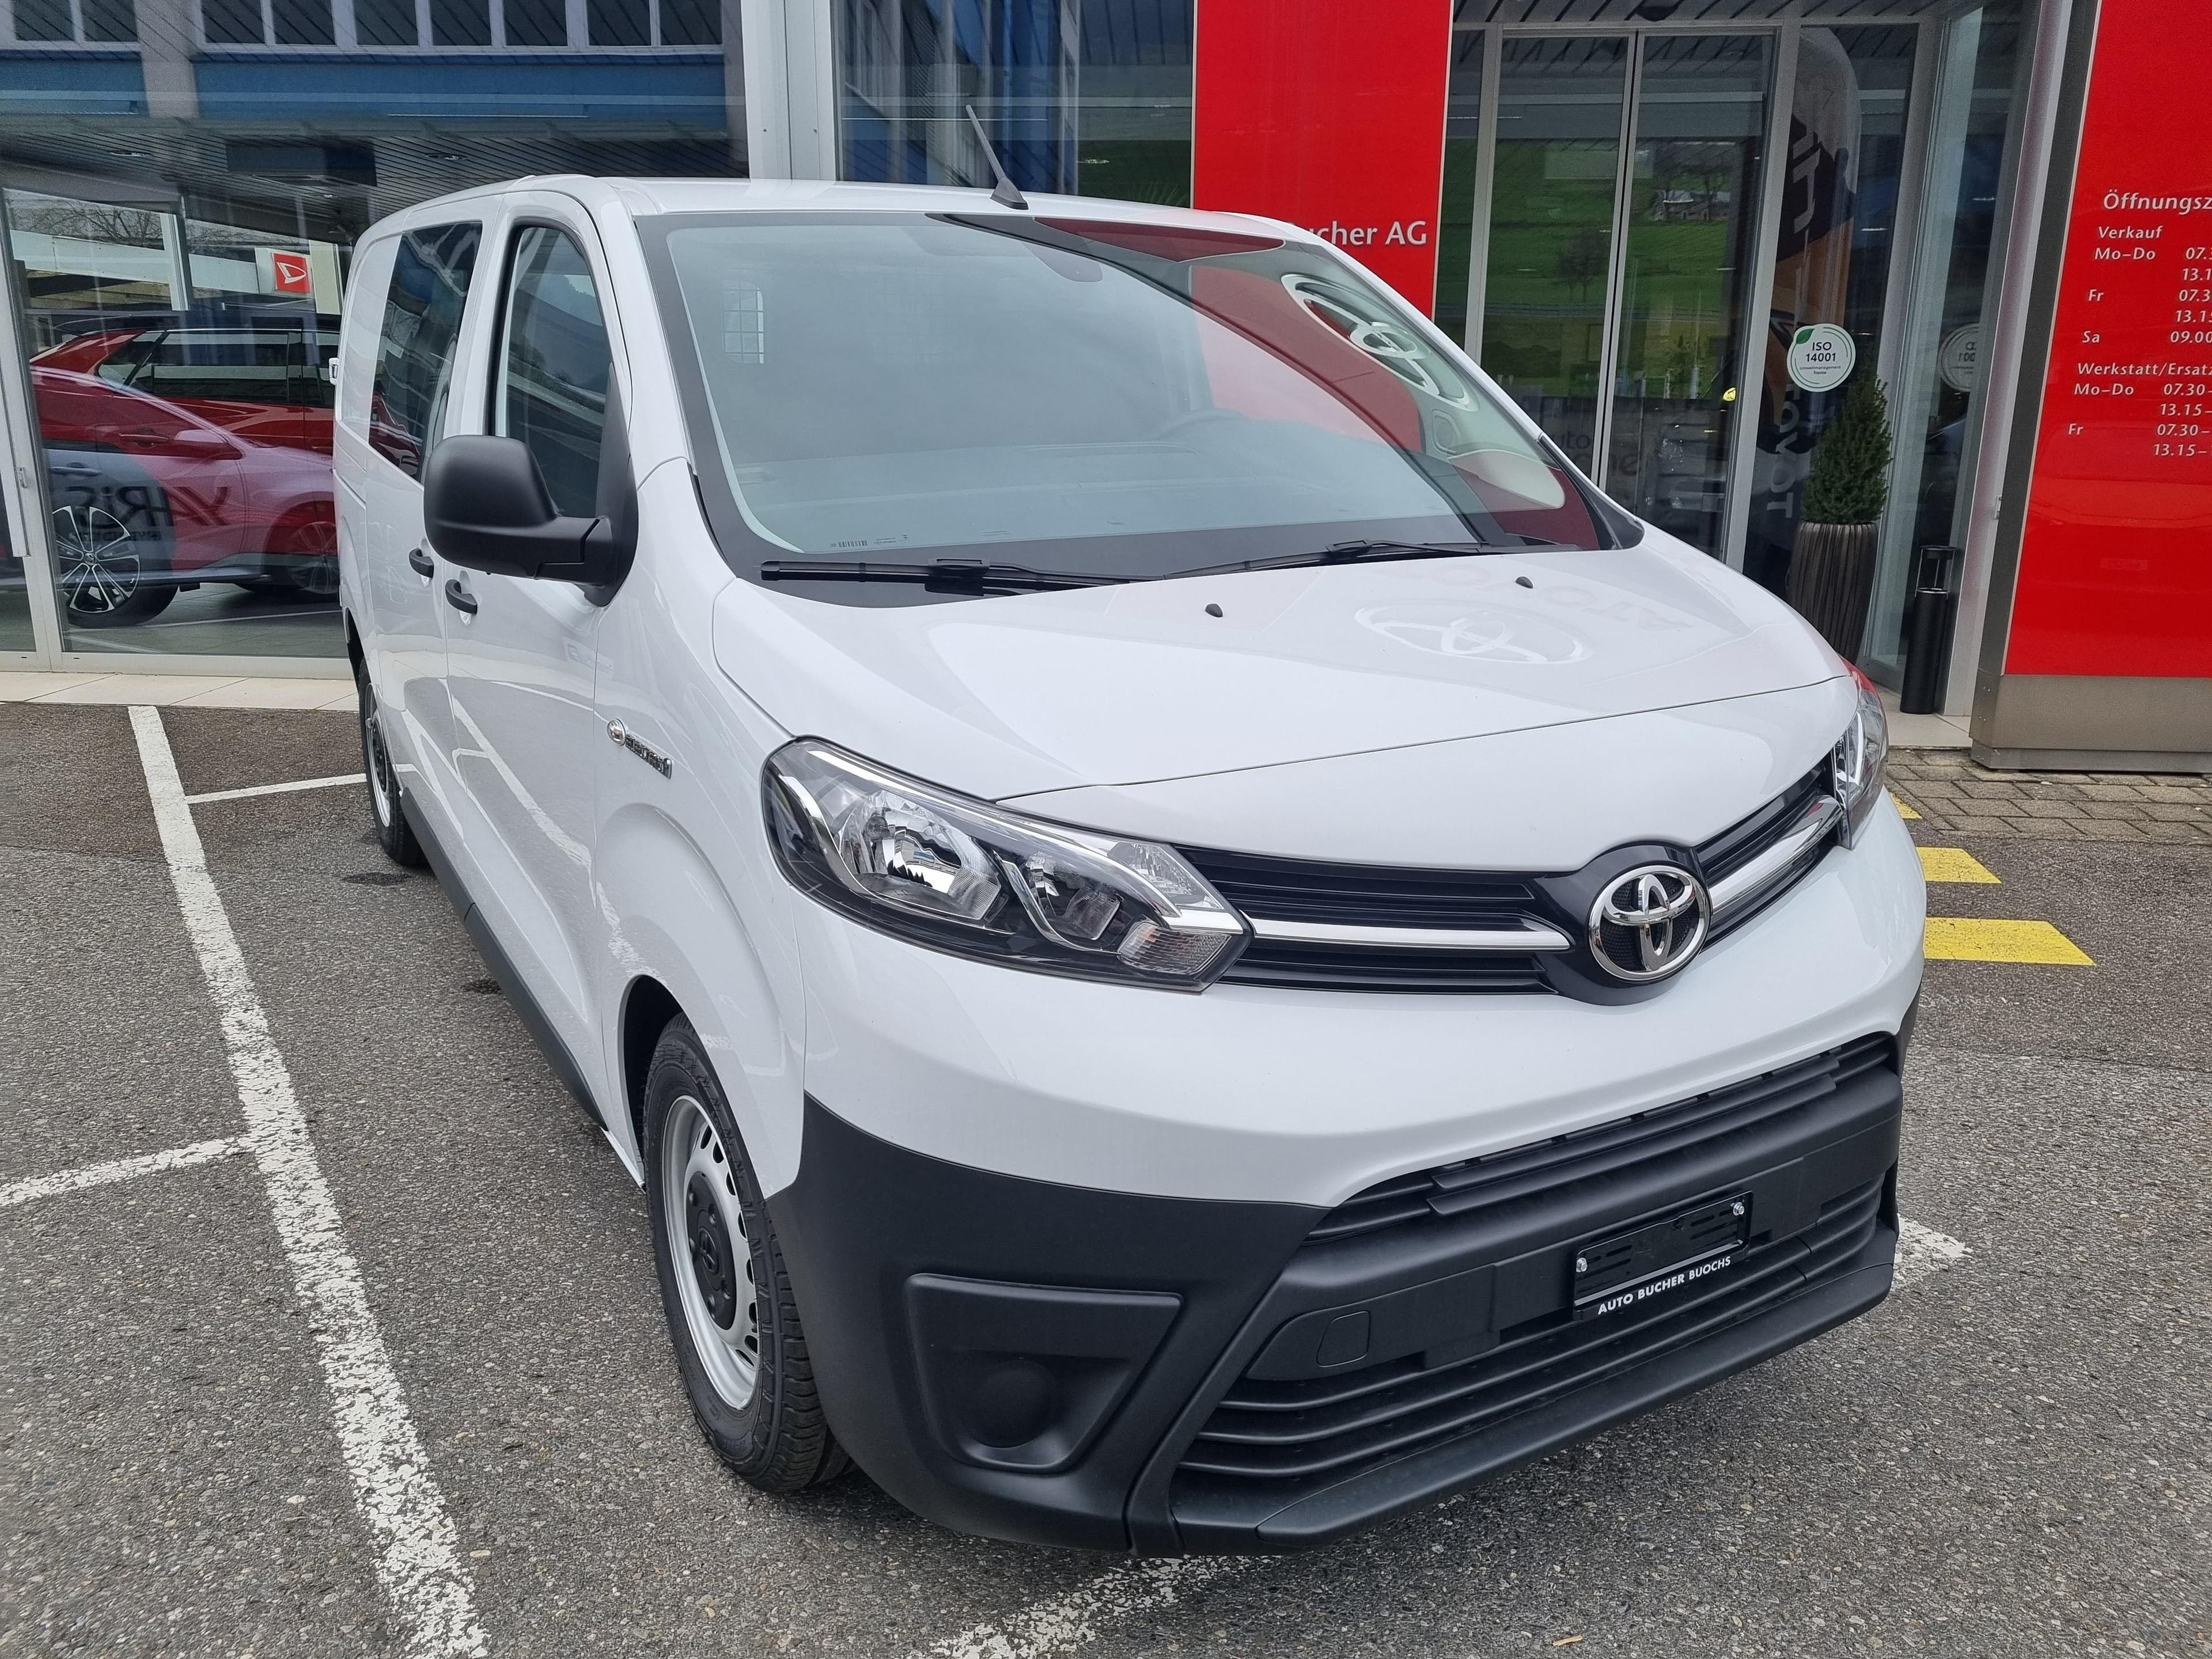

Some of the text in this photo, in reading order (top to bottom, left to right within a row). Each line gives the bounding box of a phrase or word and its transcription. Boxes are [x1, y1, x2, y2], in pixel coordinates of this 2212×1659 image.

[2104, 189, 2212, 215] Öffnungsz
[1384, 220, 1427, 245] AG
[2099, 225, 2163, 238] Verkauf
[2088, 289, 2211, 302] Fr 07.3
[2082, 331, 2212, 343] Sa 09.00
[1812, 342, 1832, 351] ISO
[1805, 353, 1836, 362] 14001
[2164, 383, 2206, 396] 07.30
[2161, 403, 2202, 416] 13.15
[2068, 423, 2084, 435] Fr
[2157, 423, 2199, 436] 07.30
[2153, 444, 2196, 456] 13.15
[1598, 1256, 1731, 1315] AUTO BUCHER BUOCHS
